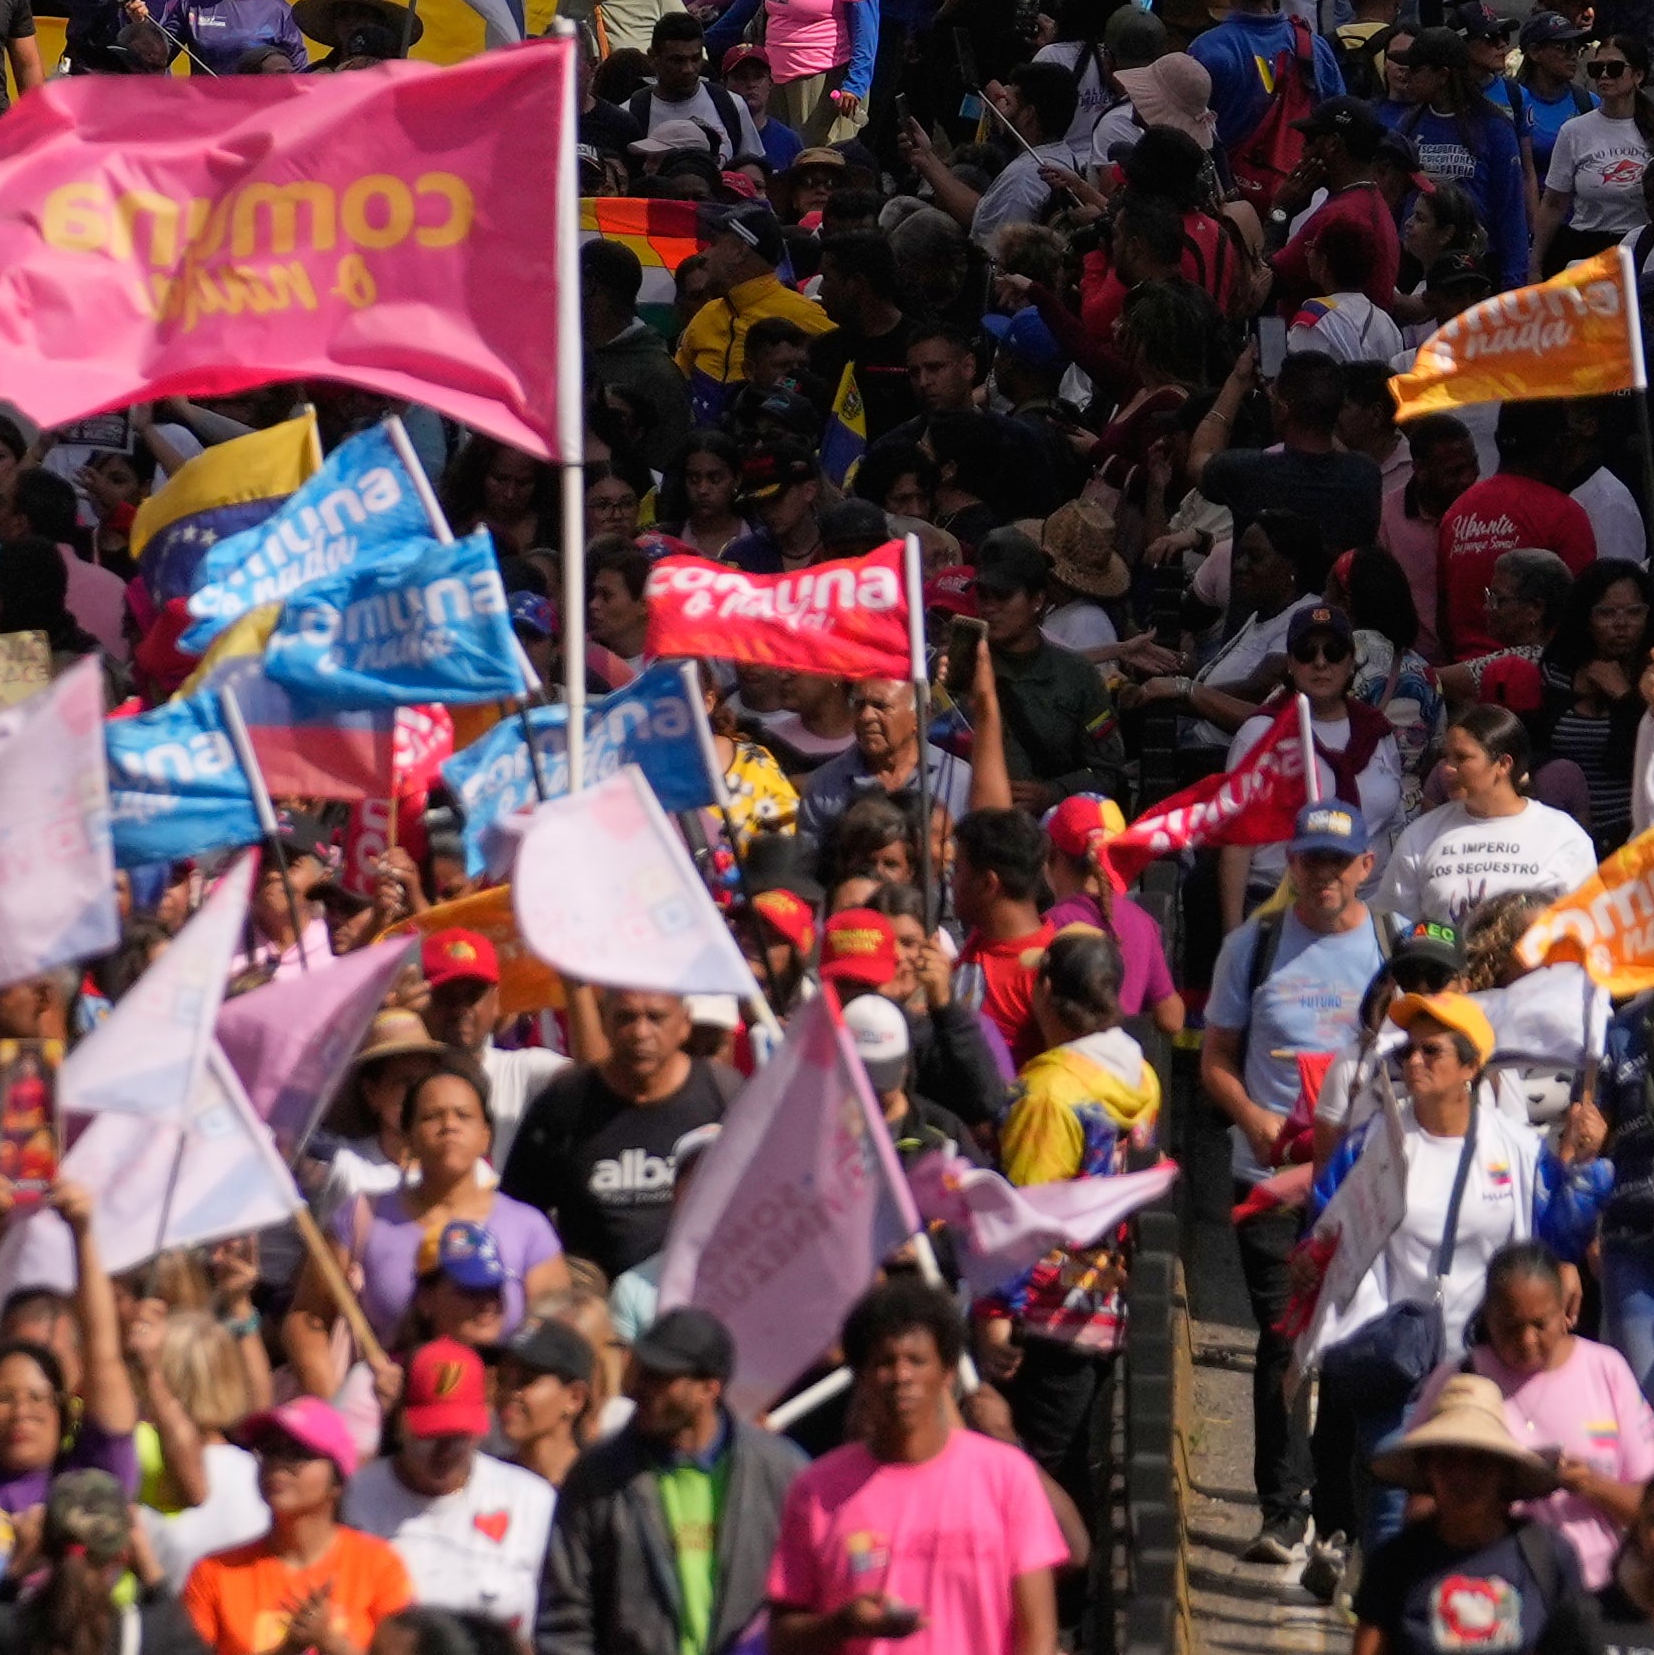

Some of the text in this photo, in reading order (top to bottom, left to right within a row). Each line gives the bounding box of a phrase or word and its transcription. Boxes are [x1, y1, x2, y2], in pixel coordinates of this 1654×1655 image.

[1441, 841, 1521, 857] EL IMPERIO
[1453, 860, 1540, 876] SECUESTRÓ
[588, 1148, 677, 1192] alb
